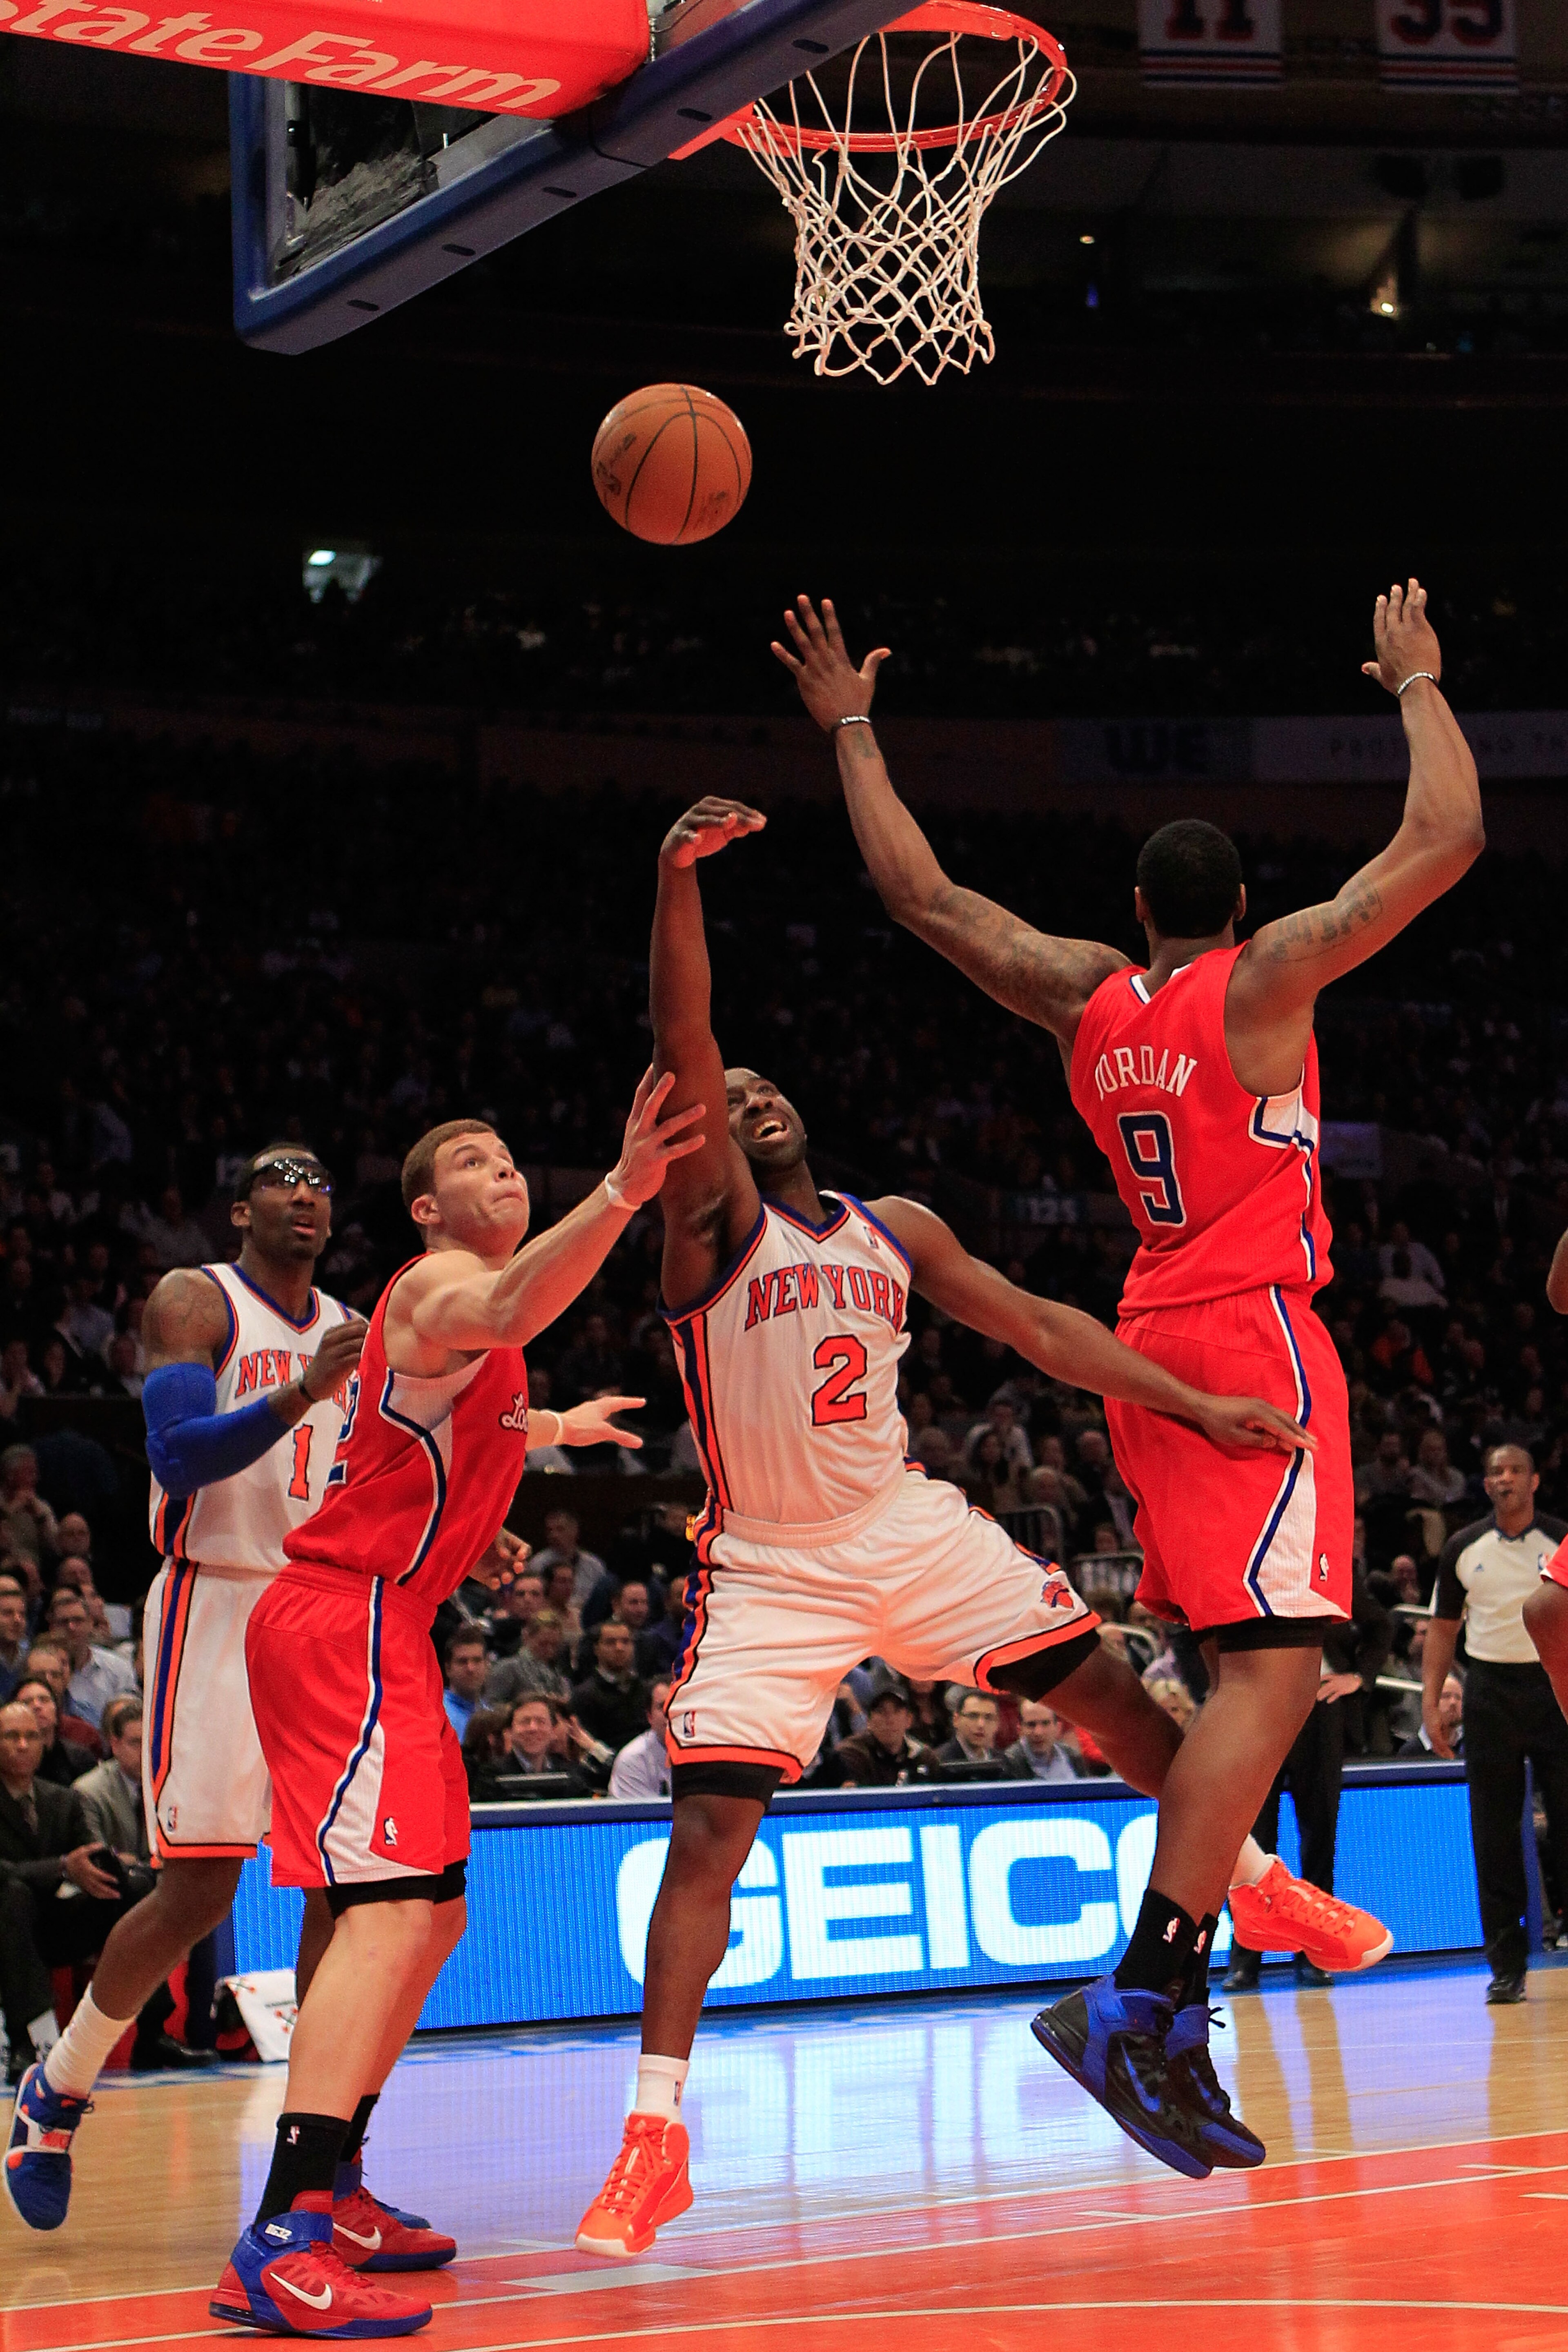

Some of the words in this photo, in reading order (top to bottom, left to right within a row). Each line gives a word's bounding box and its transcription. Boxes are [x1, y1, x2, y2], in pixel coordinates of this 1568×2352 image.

[0, 0, 263, 62] tate
[244, 30, 561, 109] Farm
[1117, 1111, 1187, 1228] 9
[744, 1263, 819, 1332] NEW
[821, 1265, 906, 1333] YORK
[235, 1349, 291, 1399] NEW
[812, 1334, 868, 1427] 2
[288, 1423, 313, 1501] 1
